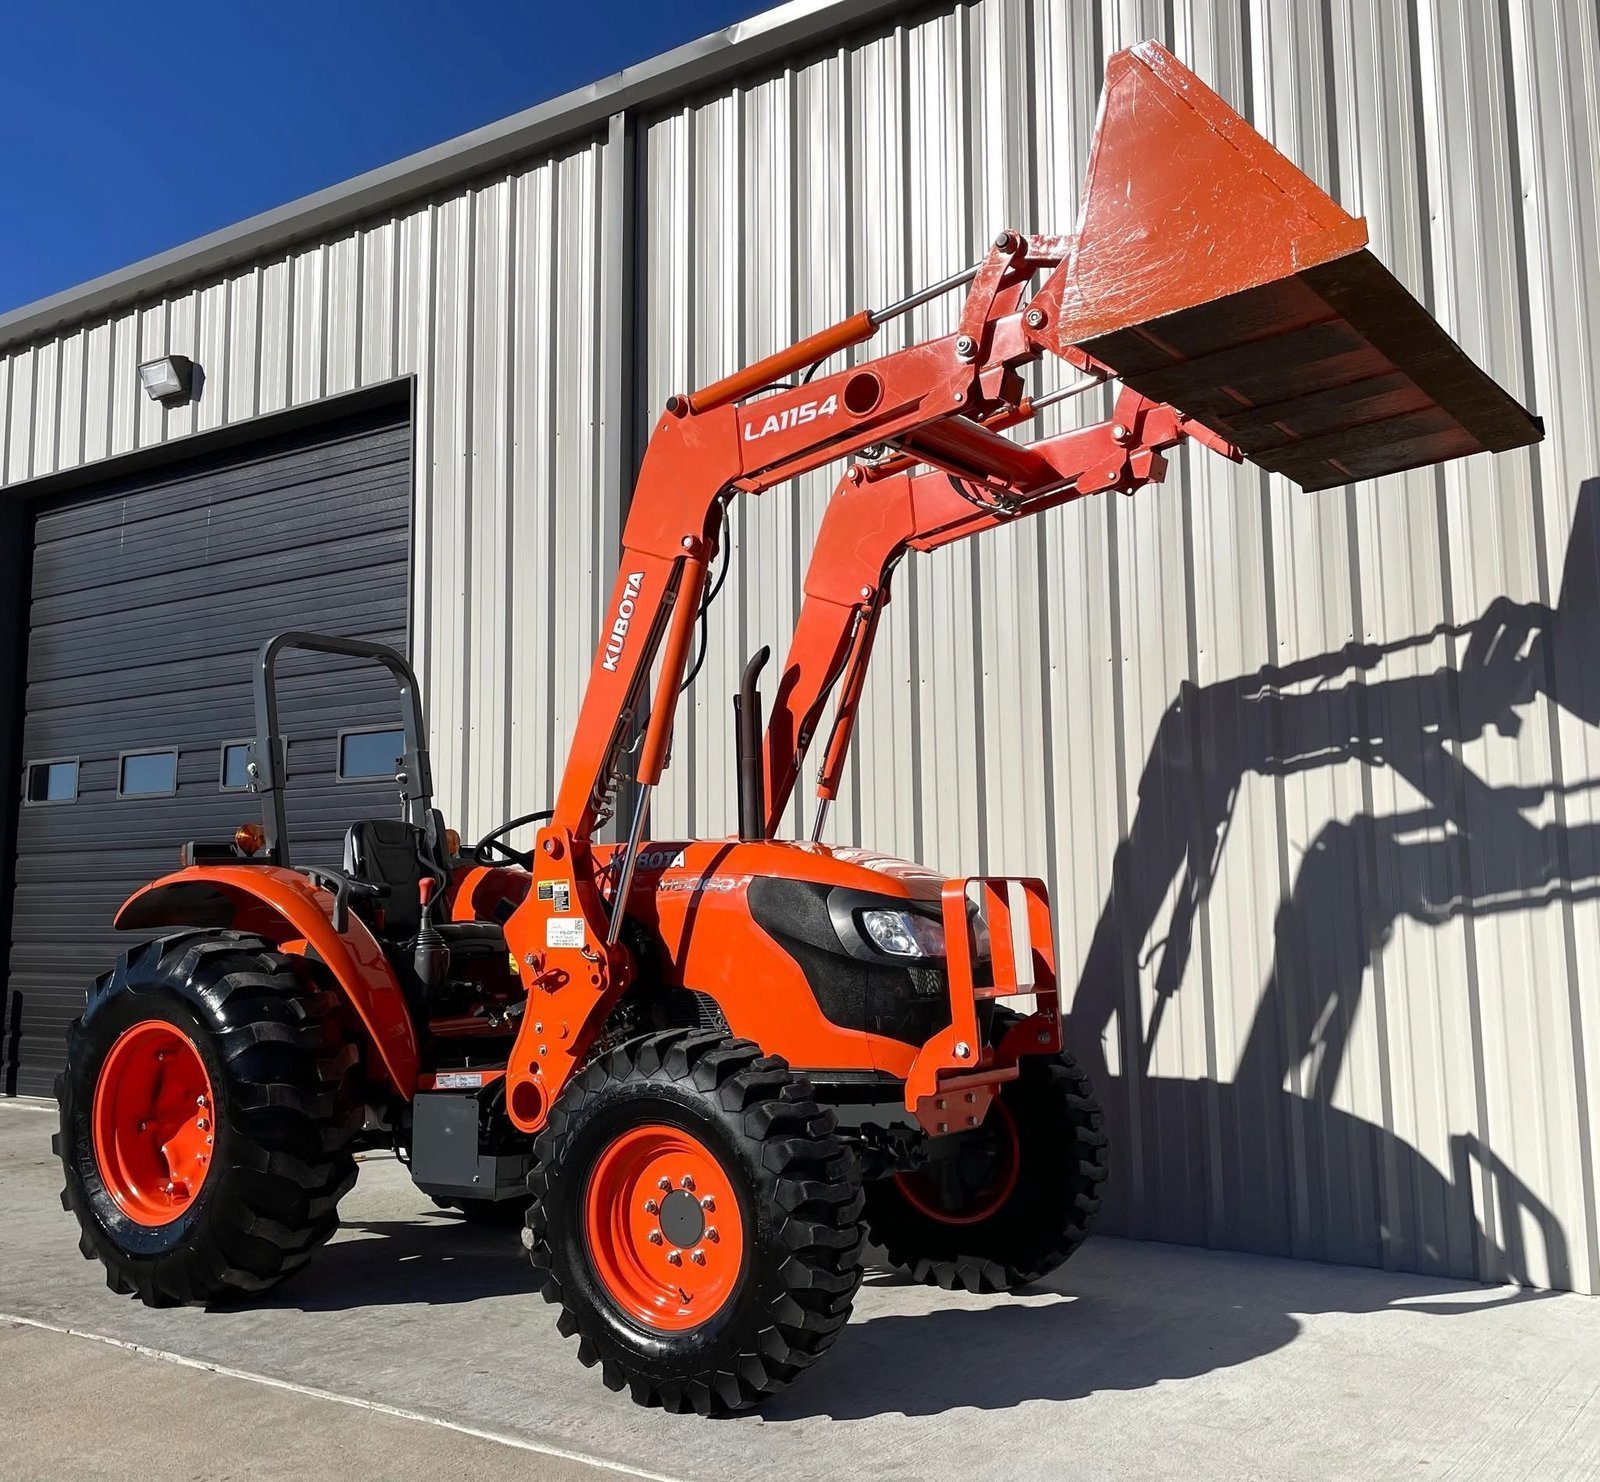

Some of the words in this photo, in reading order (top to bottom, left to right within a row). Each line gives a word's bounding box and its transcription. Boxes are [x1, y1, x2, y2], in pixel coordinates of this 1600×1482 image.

[744, 394, 838, 441] LA1154
[602, 572, 645, 672] KUBOTA
[609, 850, 685, 870] KBOTA
